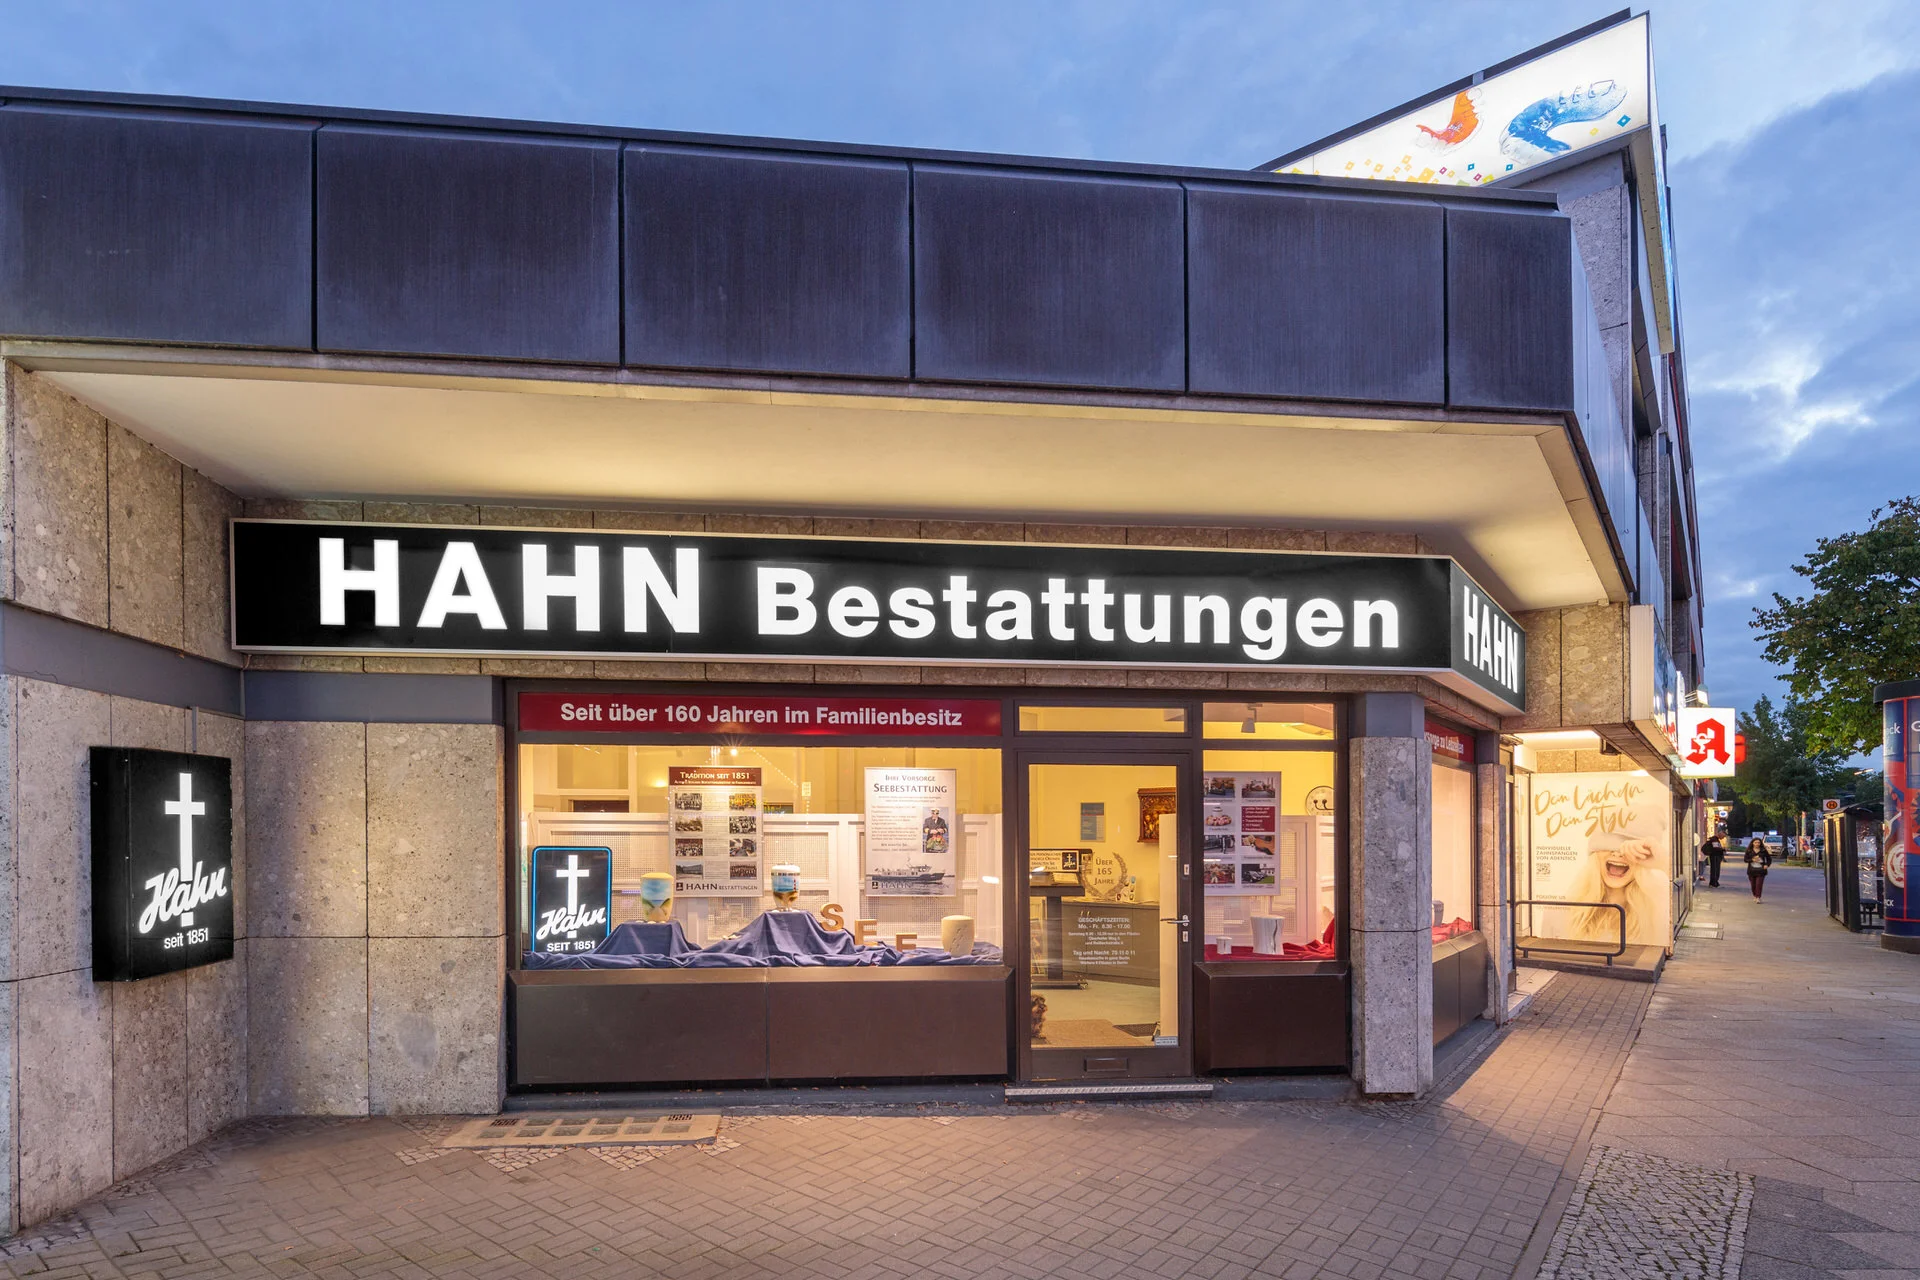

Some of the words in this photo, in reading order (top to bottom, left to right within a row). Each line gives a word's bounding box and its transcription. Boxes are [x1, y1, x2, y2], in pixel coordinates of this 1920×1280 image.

[319, 537, 700, 633] HAHN
[756, 567, 1400, 660] Bestattungen
[1463, 584, 1519, 694] HAHN
[560, 703, 602, 721] Seit
[609, 703, 657, 721] über
[664, 705, 701, 722] 160
[707, 705, 778, 723] Jahren
[785, 706, 809, 724] im
[816, 706, 963, 726] Familienbesitz
[732, 772, 750, 780] 1851
[874, 783, 948, 792] SEEBESTATTUNG
[1534, 790, 1570, 816] Dein
[1546, 812, 1582, 838] Dein
[1585, 804, 1637, 838] Style
[139, 861, 227, 934] Hahn
[536, 904, 606, 940] Hahn
[164, 933, 184, 949] seit
[186, 928, 209, 946] 1851
[546, 942, 570, 952] SEIT
[574, 940, 596, 950] 1851
